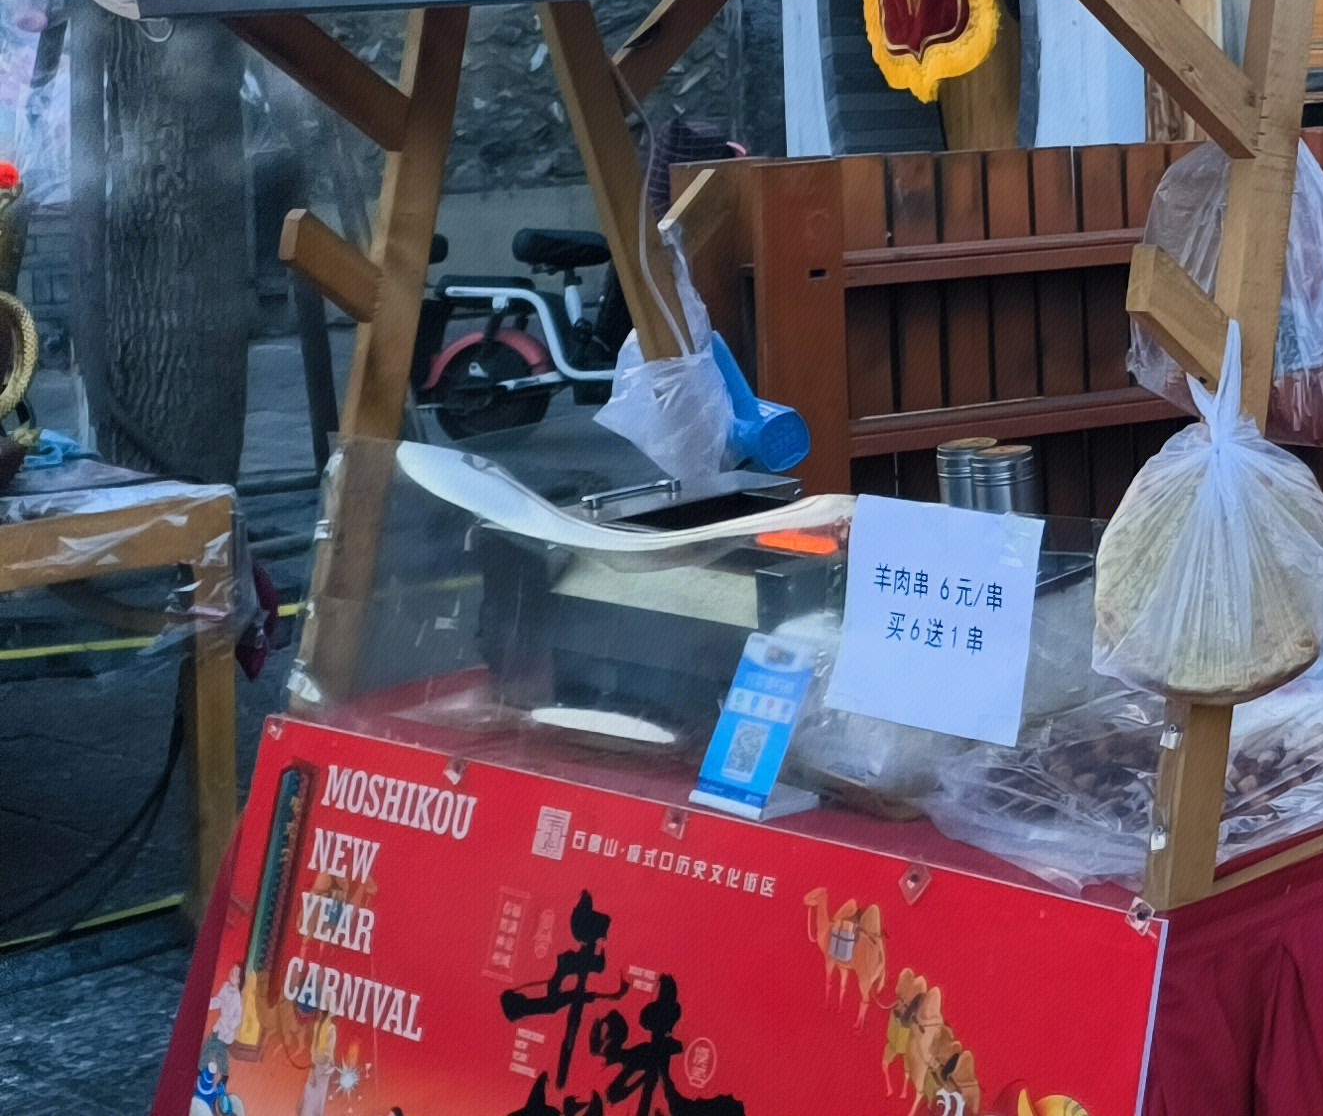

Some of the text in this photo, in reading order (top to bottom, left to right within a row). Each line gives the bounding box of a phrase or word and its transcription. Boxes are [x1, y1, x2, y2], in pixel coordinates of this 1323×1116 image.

[873, 562, 930, 599] 羊肉串
[885, 611, 983, 655] 买6送1串
[320, 765, 478, 841] MOSHIKOU
[308, 827, 380, 885] NEW
[297, 891, 375, 956] YEAR
[282, 955, 424, 1043] CARNIVAL
